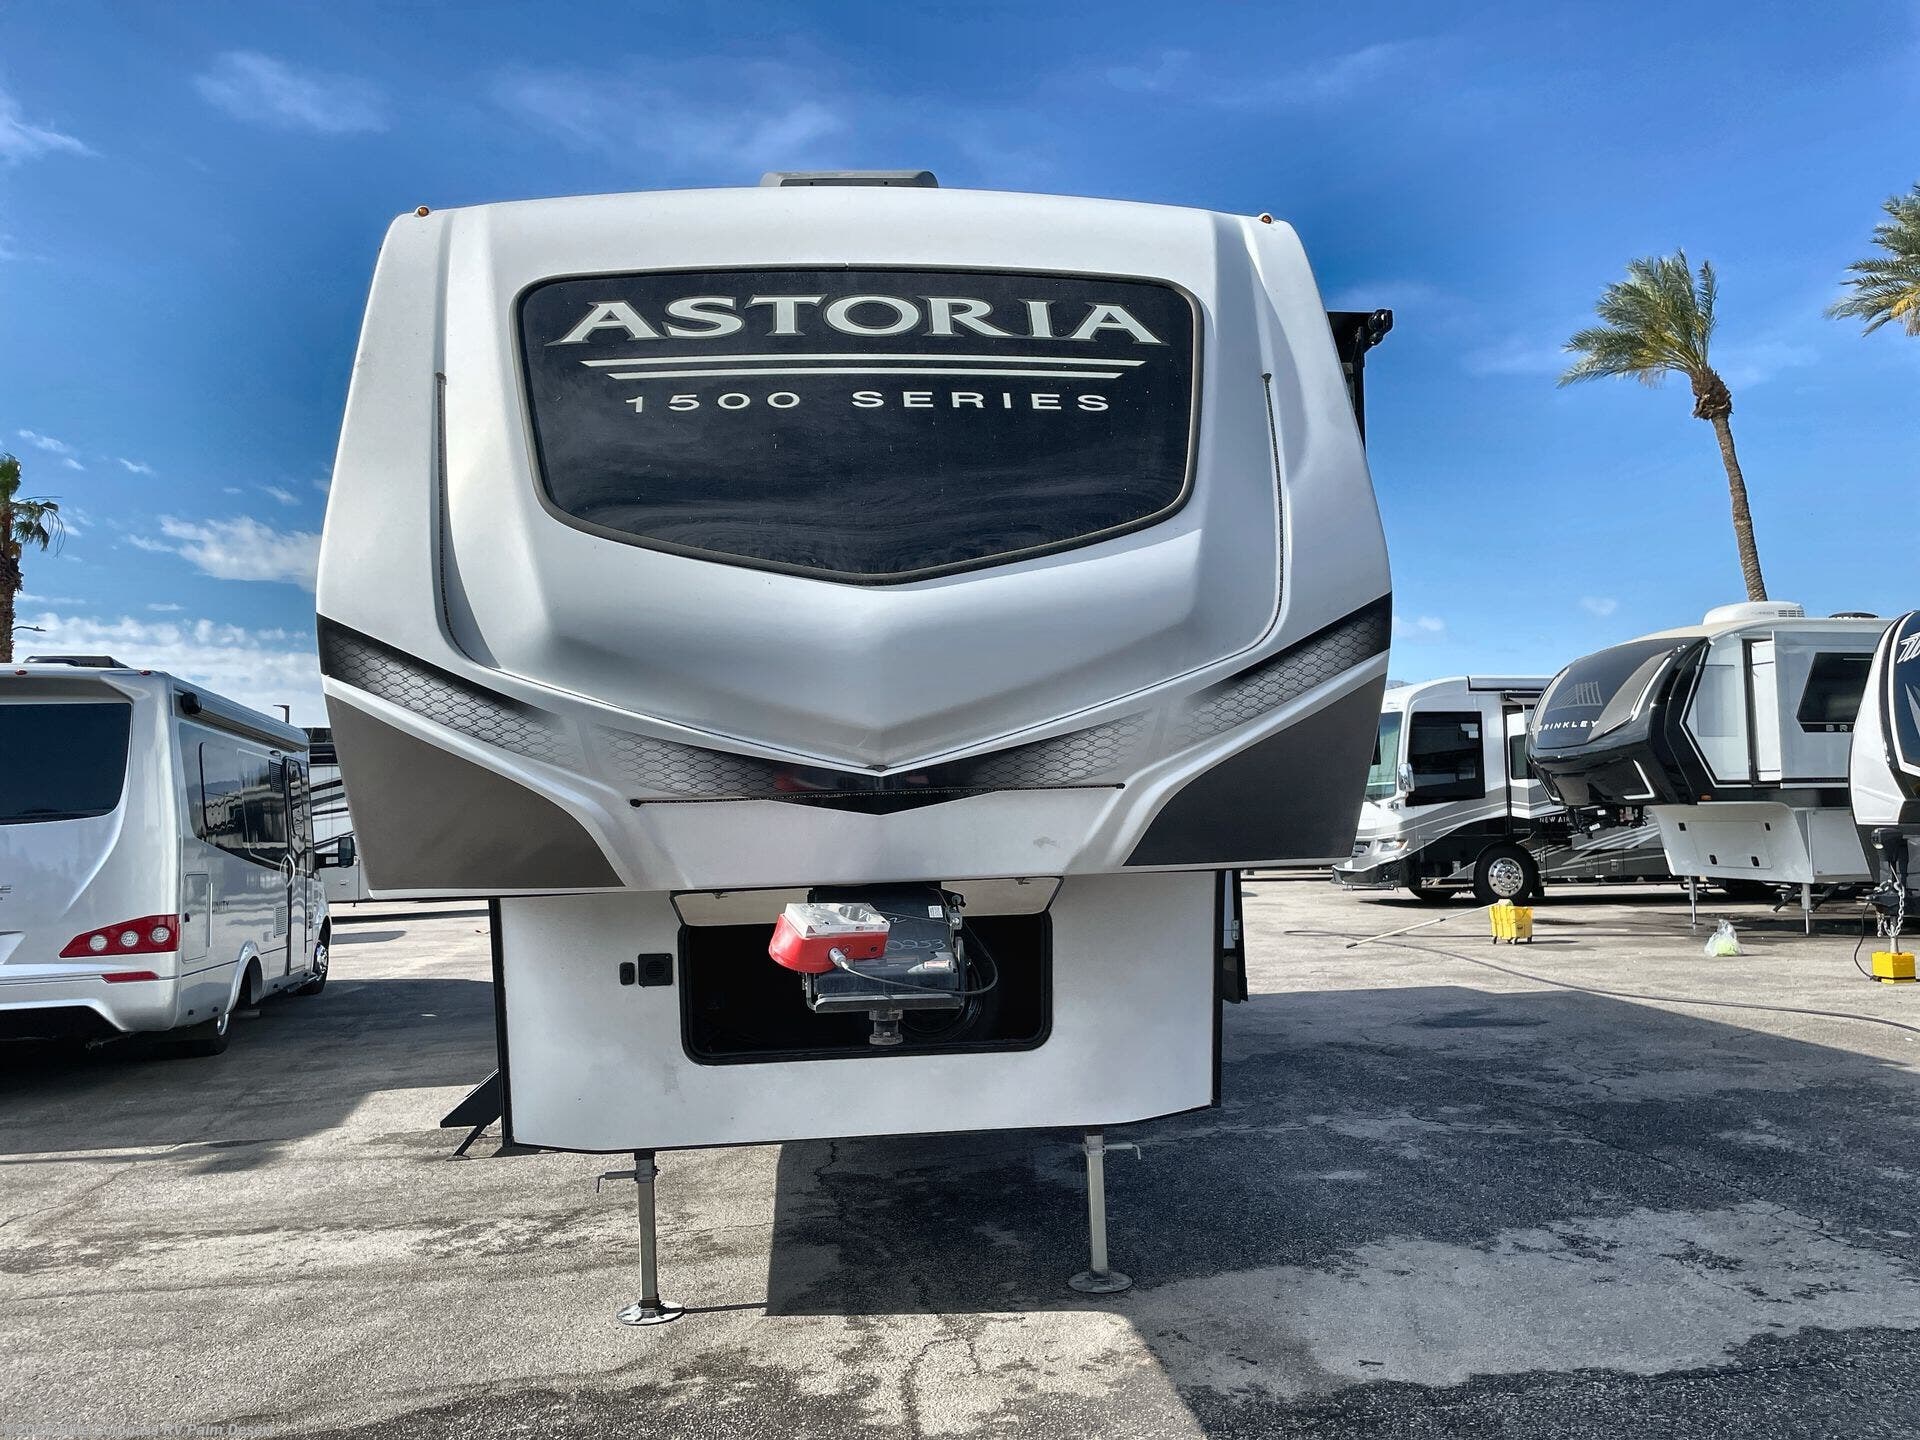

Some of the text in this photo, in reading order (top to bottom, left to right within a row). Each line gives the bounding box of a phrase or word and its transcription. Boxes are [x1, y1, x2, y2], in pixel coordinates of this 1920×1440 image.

[551, 293, 1164, 344] ASTORIA
[625, 390, 1110, 414] 1500 SERIES
